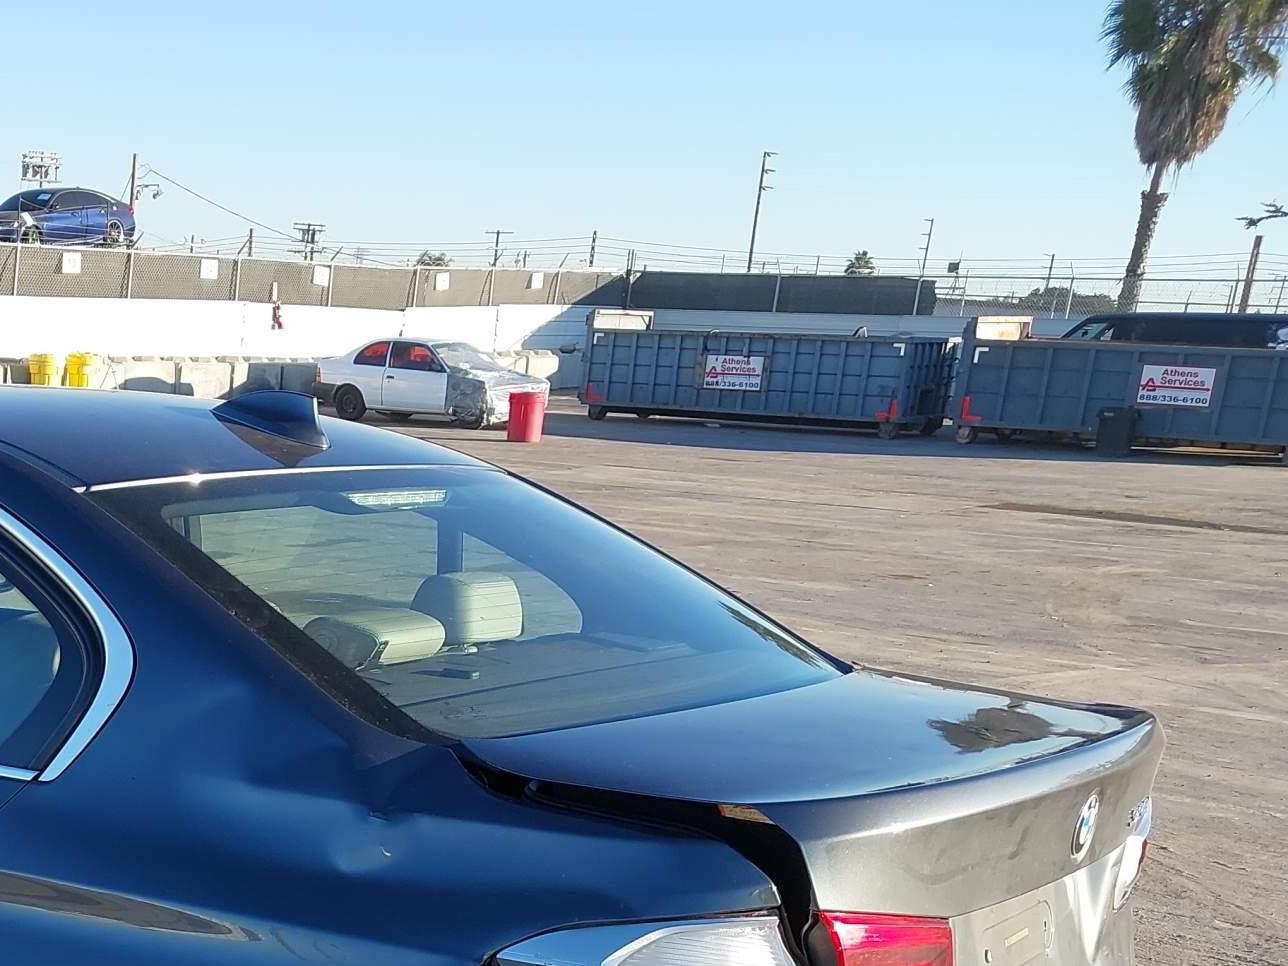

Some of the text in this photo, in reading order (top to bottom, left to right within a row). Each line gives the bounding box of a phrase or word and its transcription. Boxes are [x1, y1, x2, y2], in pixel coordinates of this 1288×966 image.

[721, 357, 751, 366] Athens
[720, 364, 757, 373] Services
[1161, 368, 1199, 378] Athens
[1159, 376, 1206, 387] Services
[1138, 393, 1208, 405] 888/336-6100
